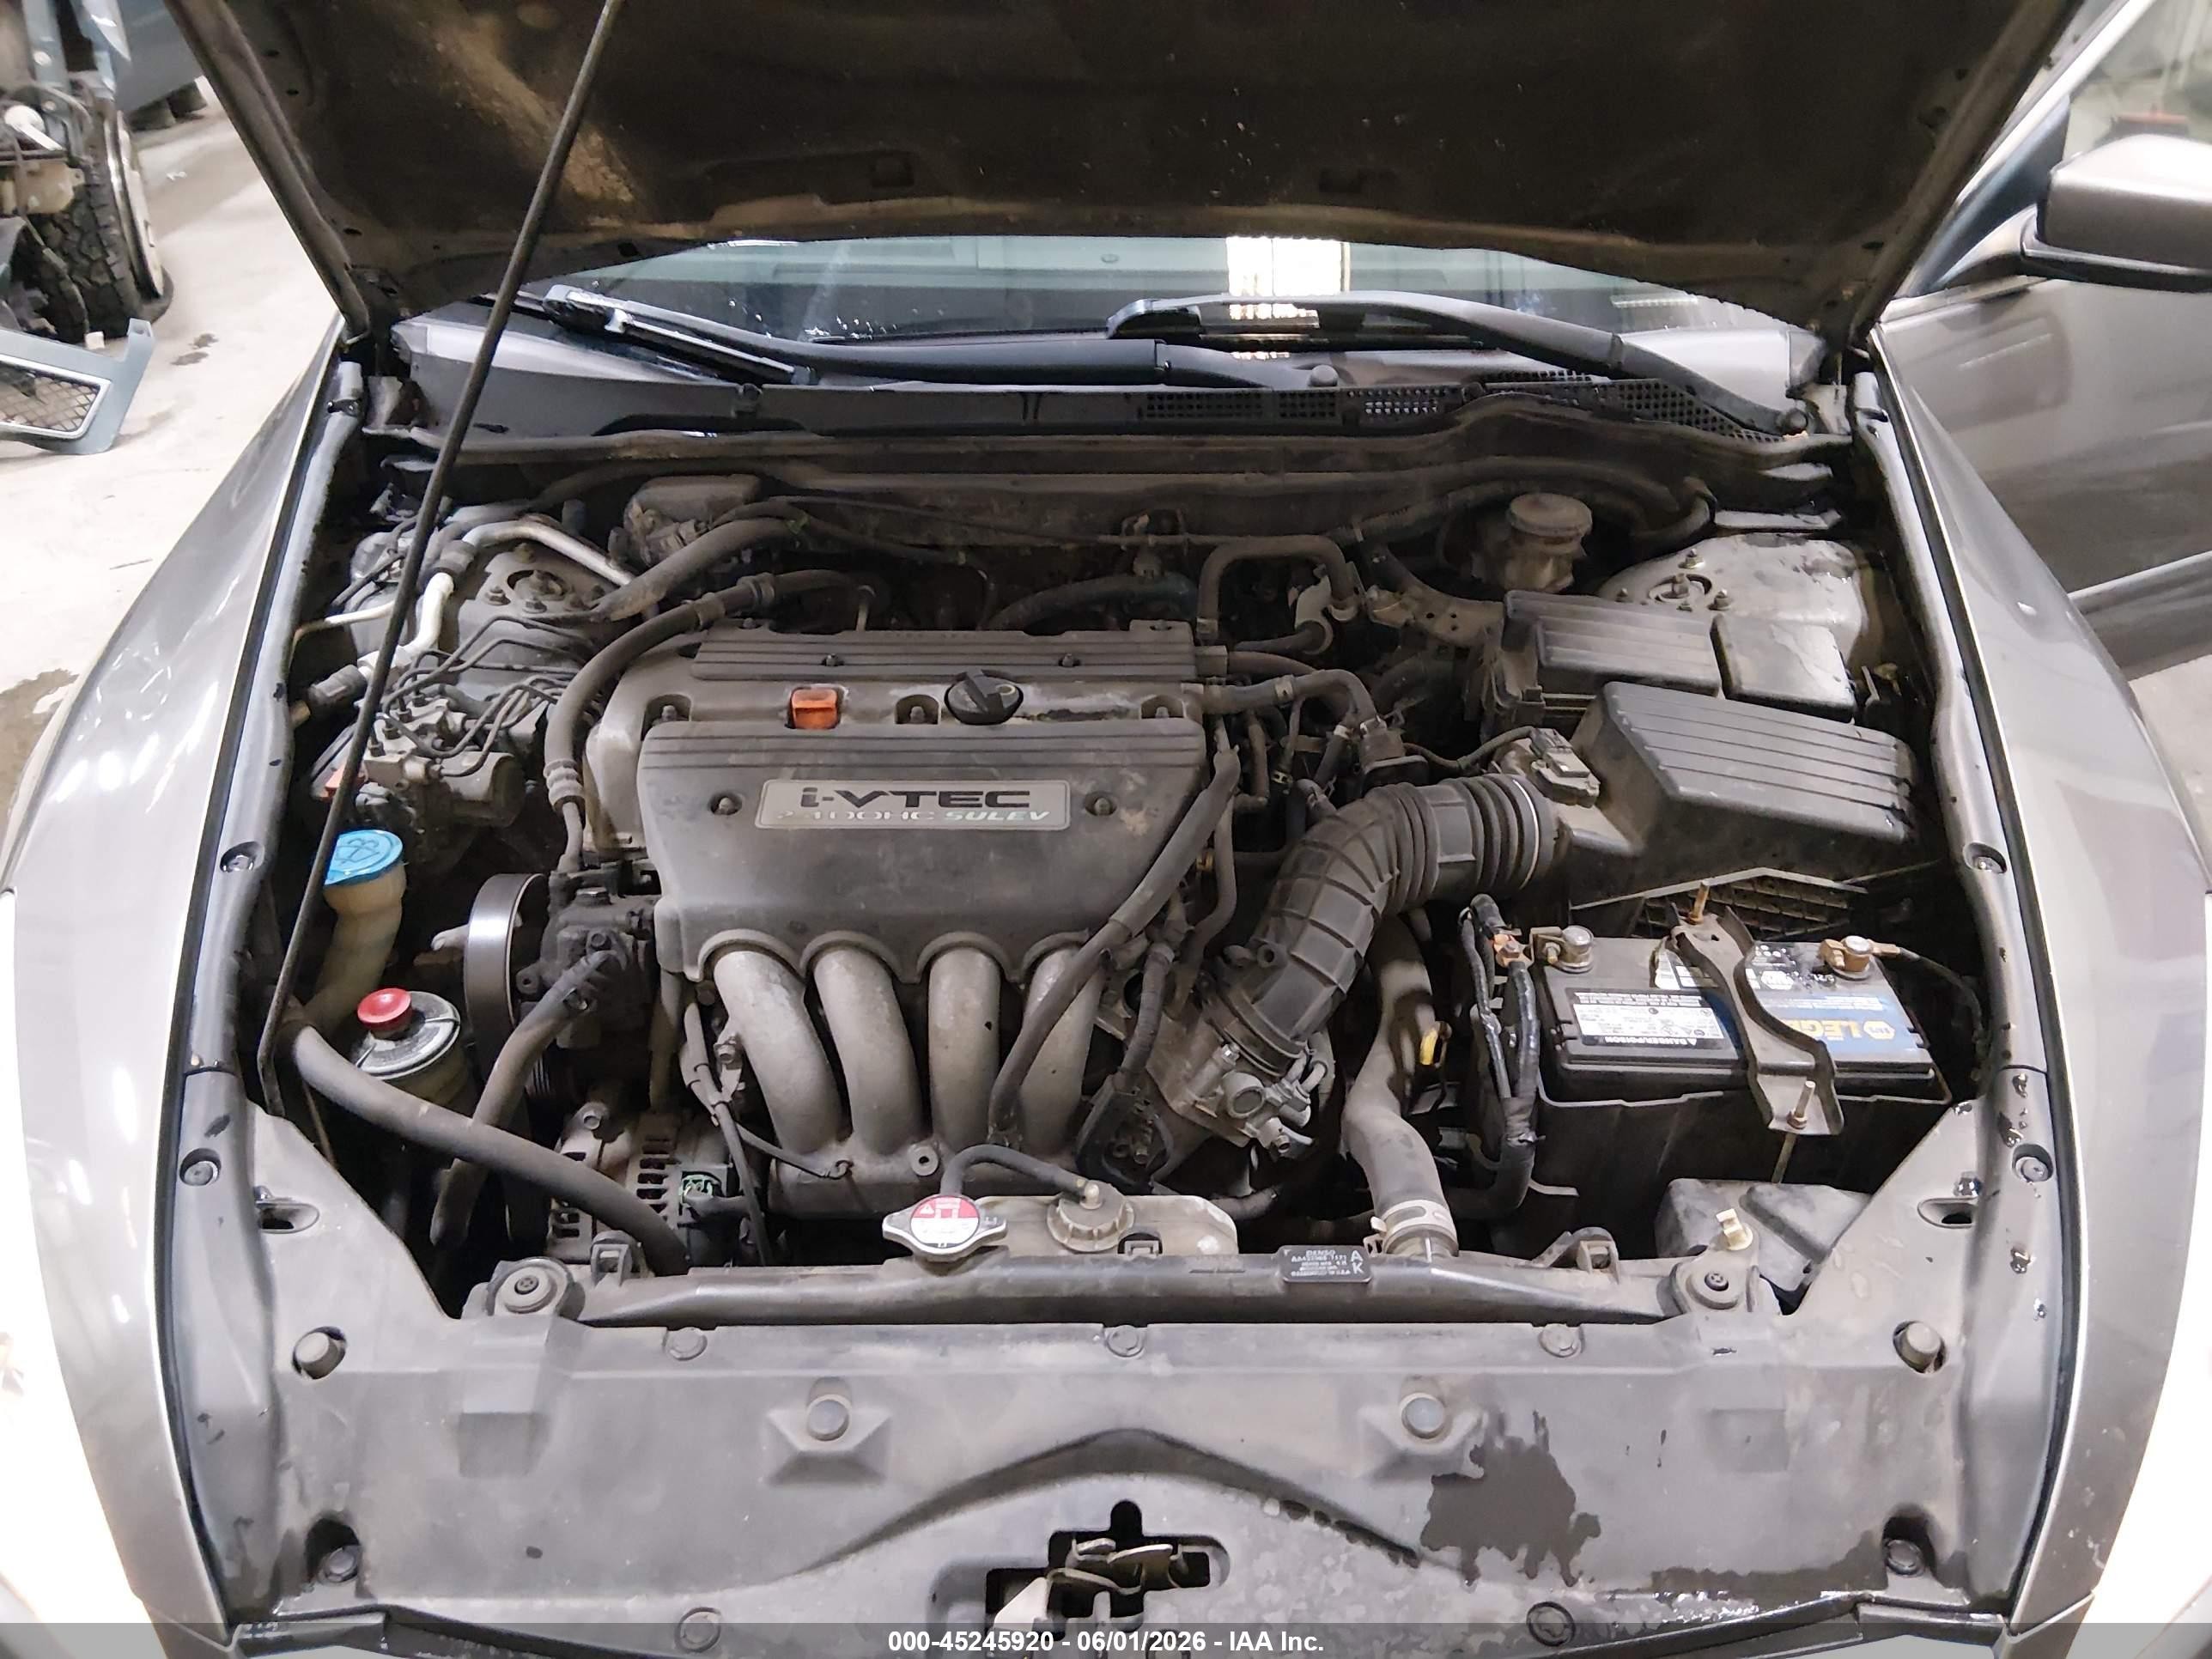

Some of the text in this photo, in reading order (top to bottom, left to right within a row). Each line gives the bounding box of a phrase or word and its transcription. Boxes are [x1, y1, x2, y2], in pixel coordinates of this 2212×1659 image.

[799, 787, 1030, 809] i-VTEC
[945, 811, 1050, 821] SULEV
[1351, 1249, 1364, 1261] A
[1352, 1261, 1364, 1274] K
